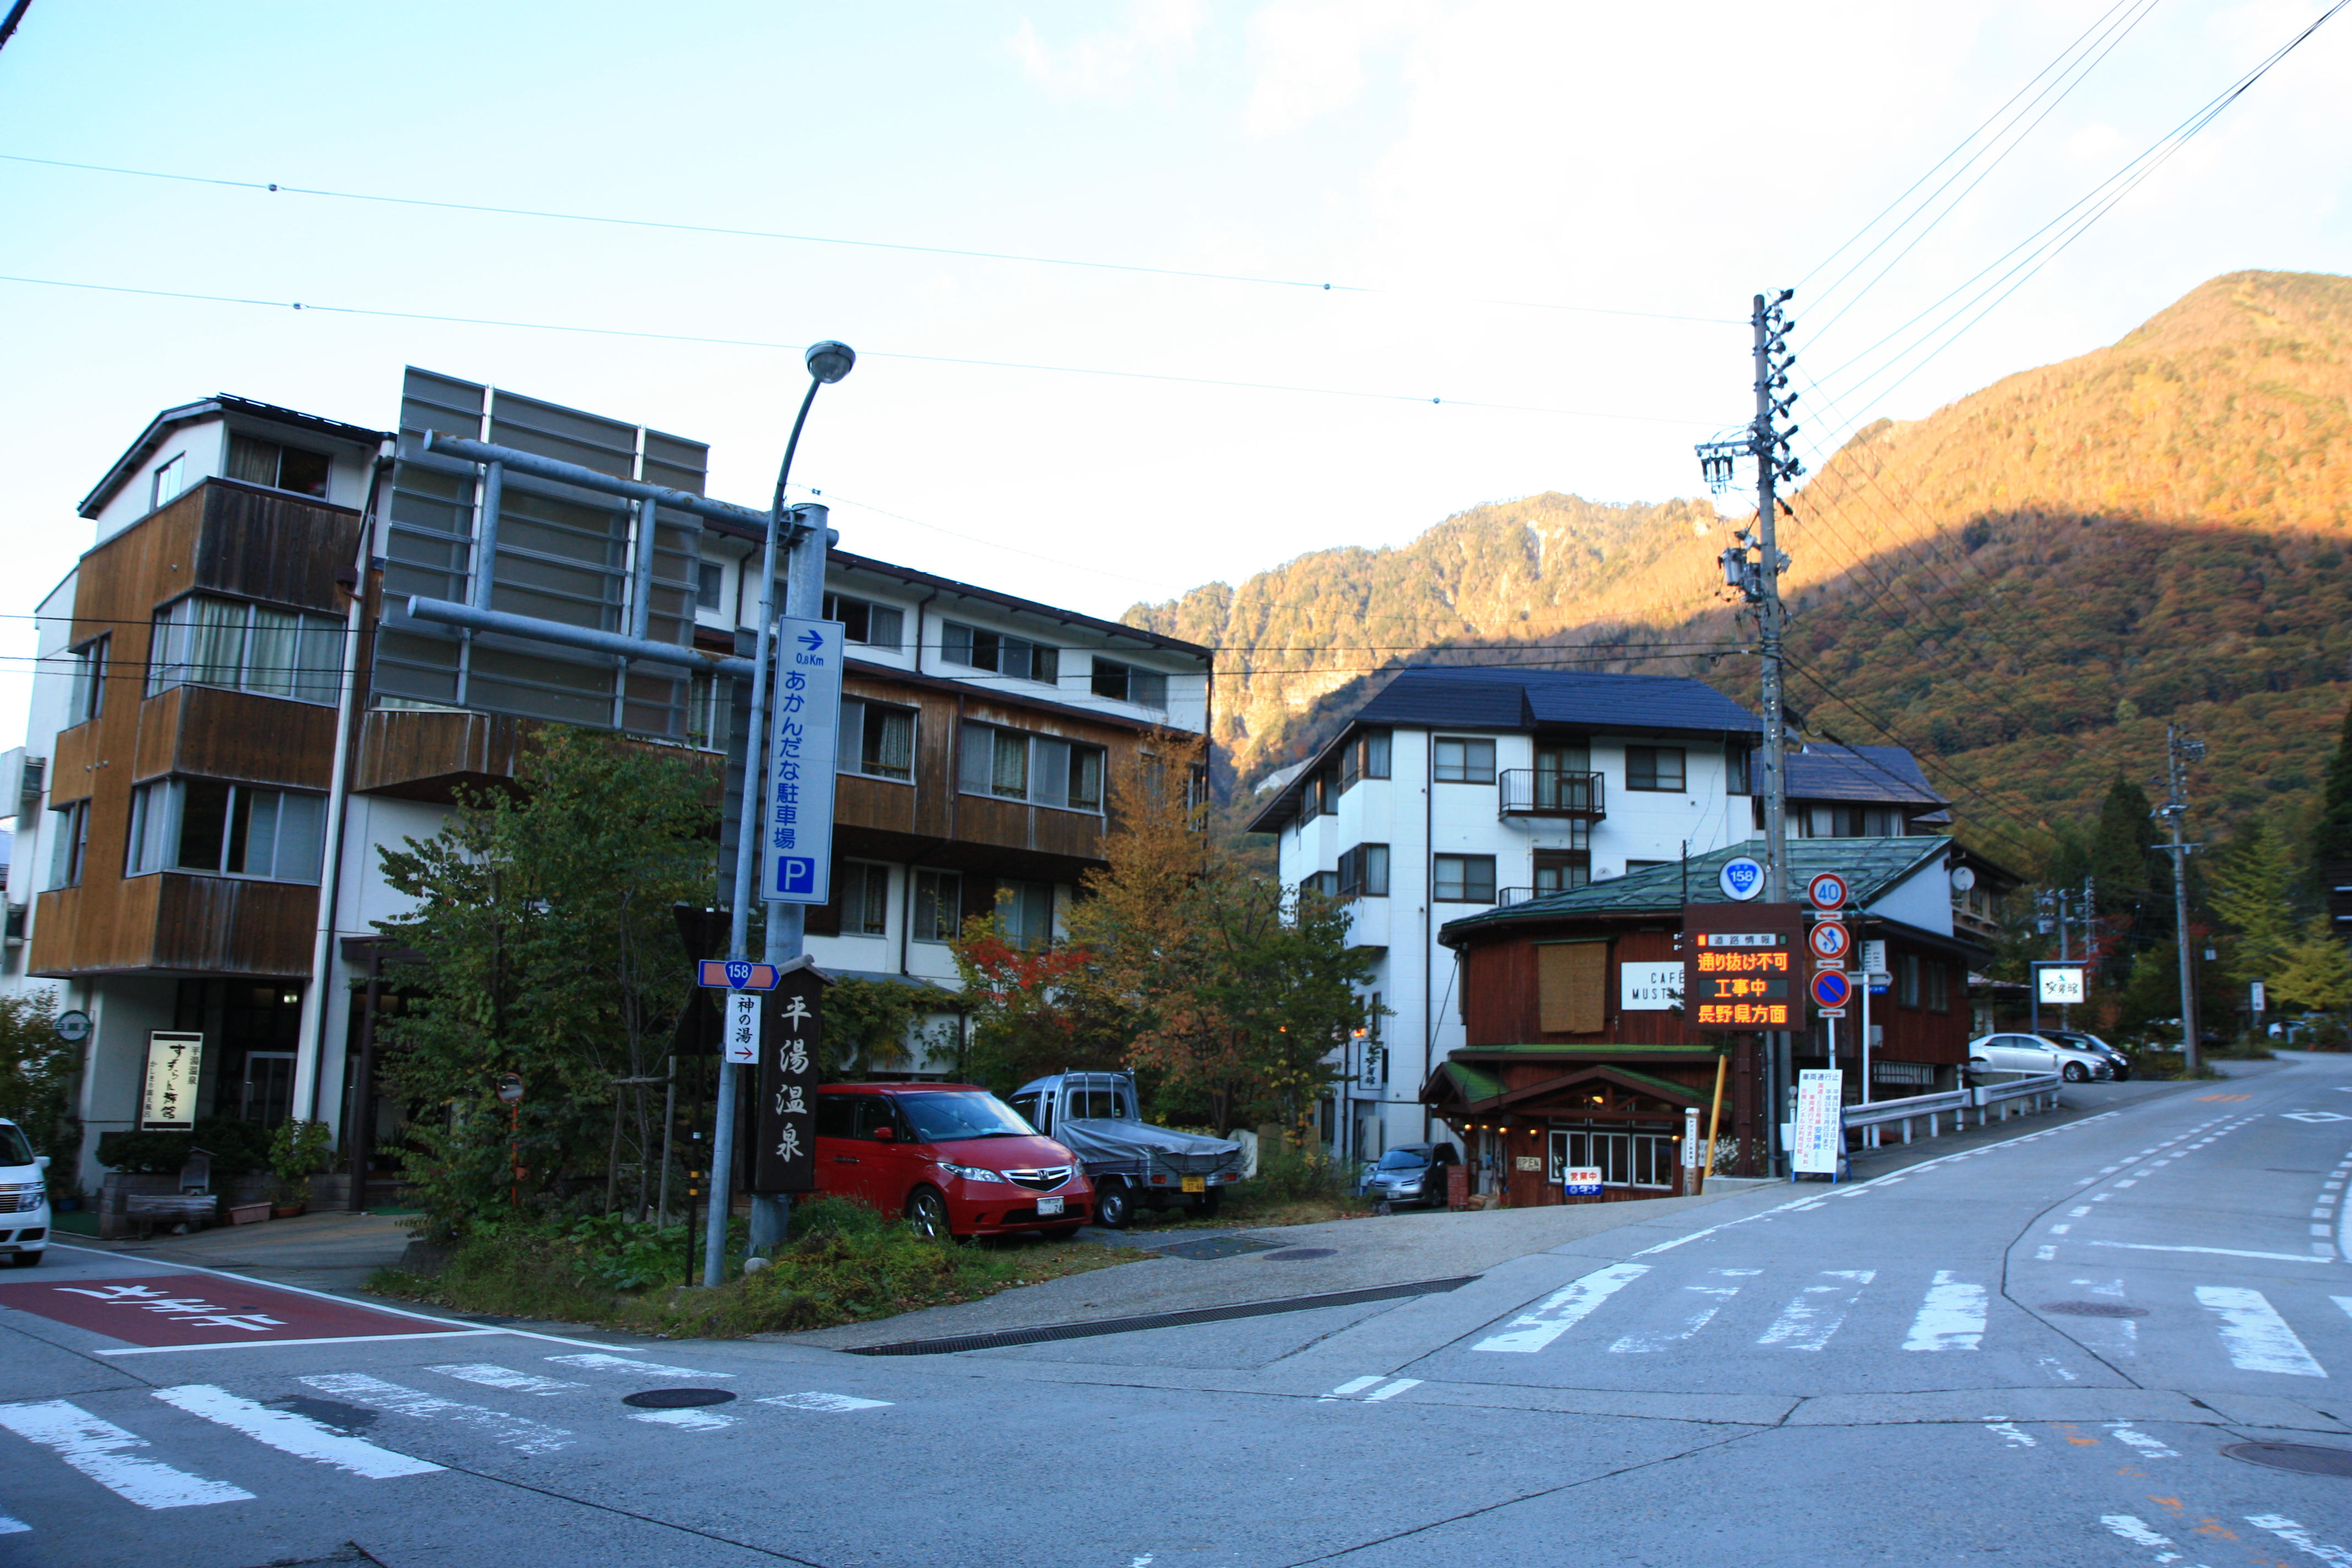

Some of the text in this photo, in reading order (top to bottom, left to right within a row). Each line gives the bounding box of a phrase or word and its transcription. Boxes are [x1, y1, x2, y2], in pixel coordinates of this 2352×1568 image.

[796, 652, 824, 667] 0.8Km
[773, 670, 807, 850] あかんだな駐車場
[1730, 870, 1754, 882] 158
[1818, 884, 1839, 900] 40
[1713, 935, 1771, 945] 道路情報
[1697, 952, 1789, 972] 通り抜け不可
[728, 964, 749, 979] 158
[1714, 978, 1767, 998] 工事中
[735, 997, 755, 1044] 神の湯
[1697, 1004, 1788, 1023] 長野県方面
[775, 995, 812, 1163] 平湯温泉
[1801, 1073, 1839, 1081] 車両通行止
[1516, 1157, 1540, 1168] OPEN
[1570, 1172, 1597, 1182] 営業中
